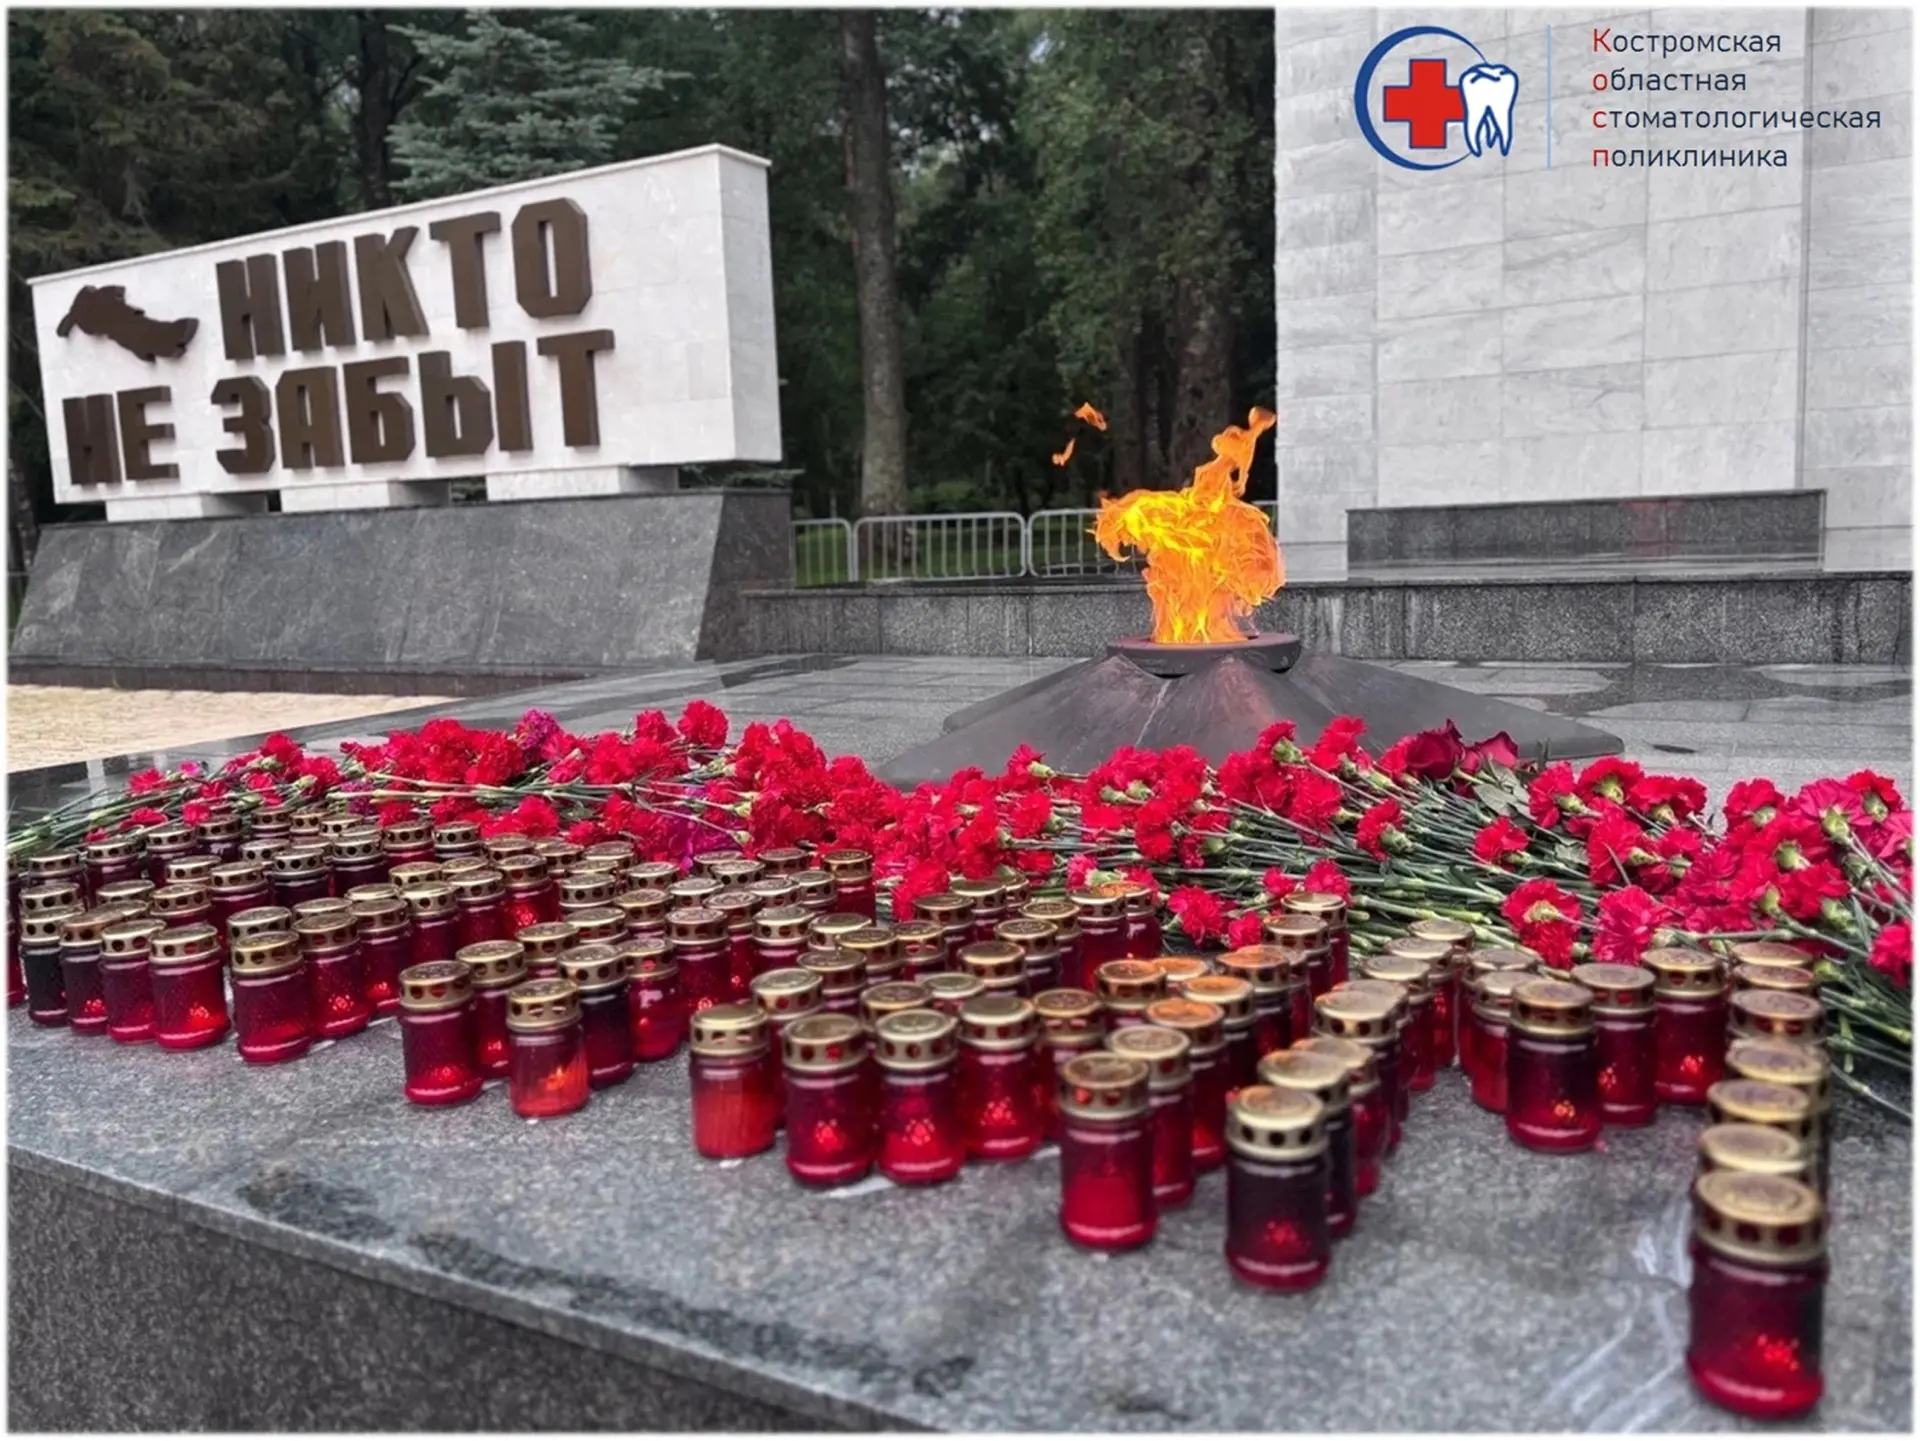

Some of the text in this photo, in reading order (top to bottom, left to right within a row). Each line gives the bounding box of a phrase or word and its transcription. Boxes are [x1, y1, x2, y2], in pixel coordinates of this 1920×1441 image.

[215, 197, 592, 361] НИКТО
[62, 329, 616, 486] НЕ ЗАБЫТ
